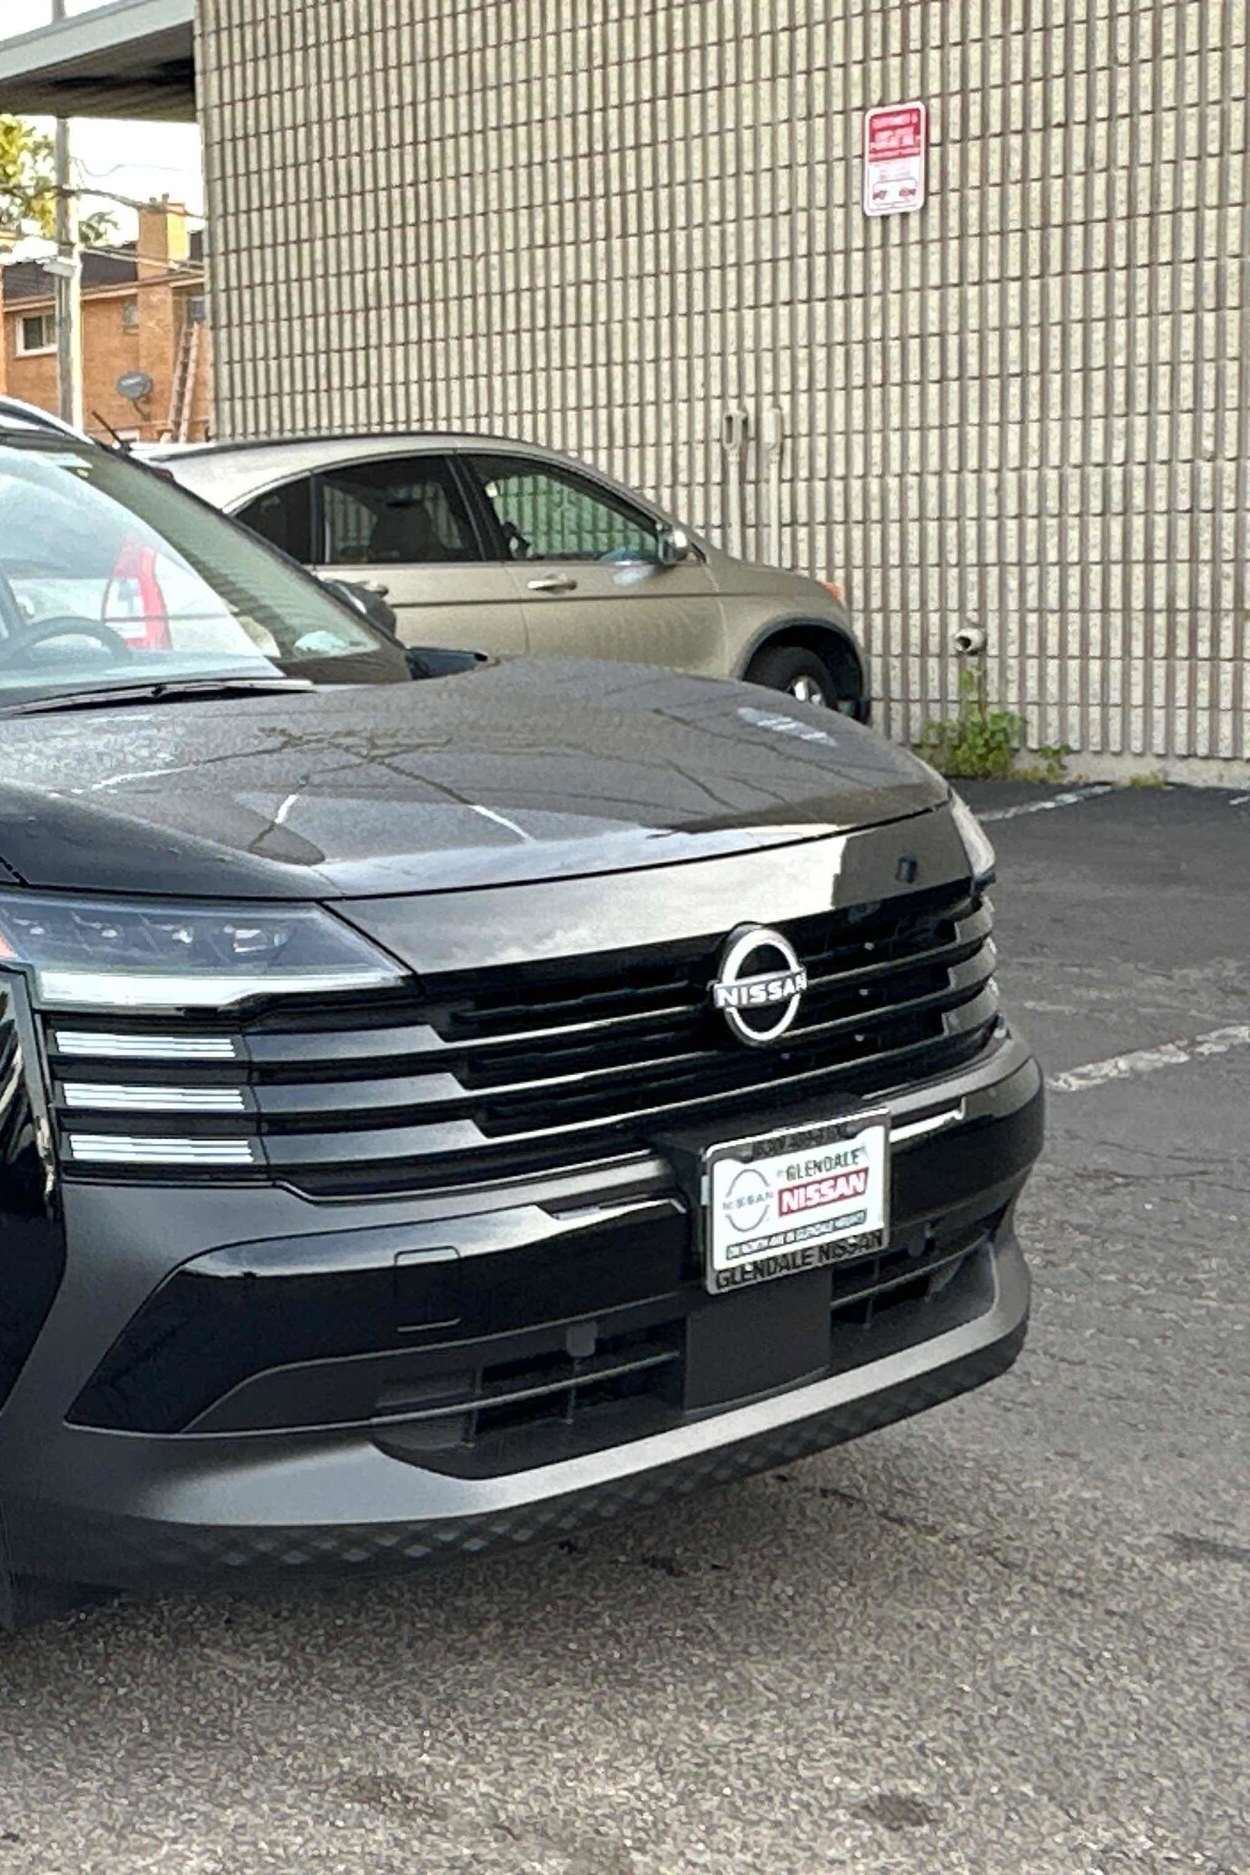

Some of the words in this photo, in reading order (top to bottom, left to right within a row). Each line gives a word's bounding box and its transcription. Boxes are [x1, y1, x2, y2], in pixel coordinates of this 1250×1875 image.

[716, 972, 807, 1007] NISSAN
[786, 1148, 860, 1181] GLENDALE
[780, 1170, 867, 1213] NISSAN
[715, 1248, 815, 1289] GLENDALE
[818, 1230, 883, 1263] NISSAN
